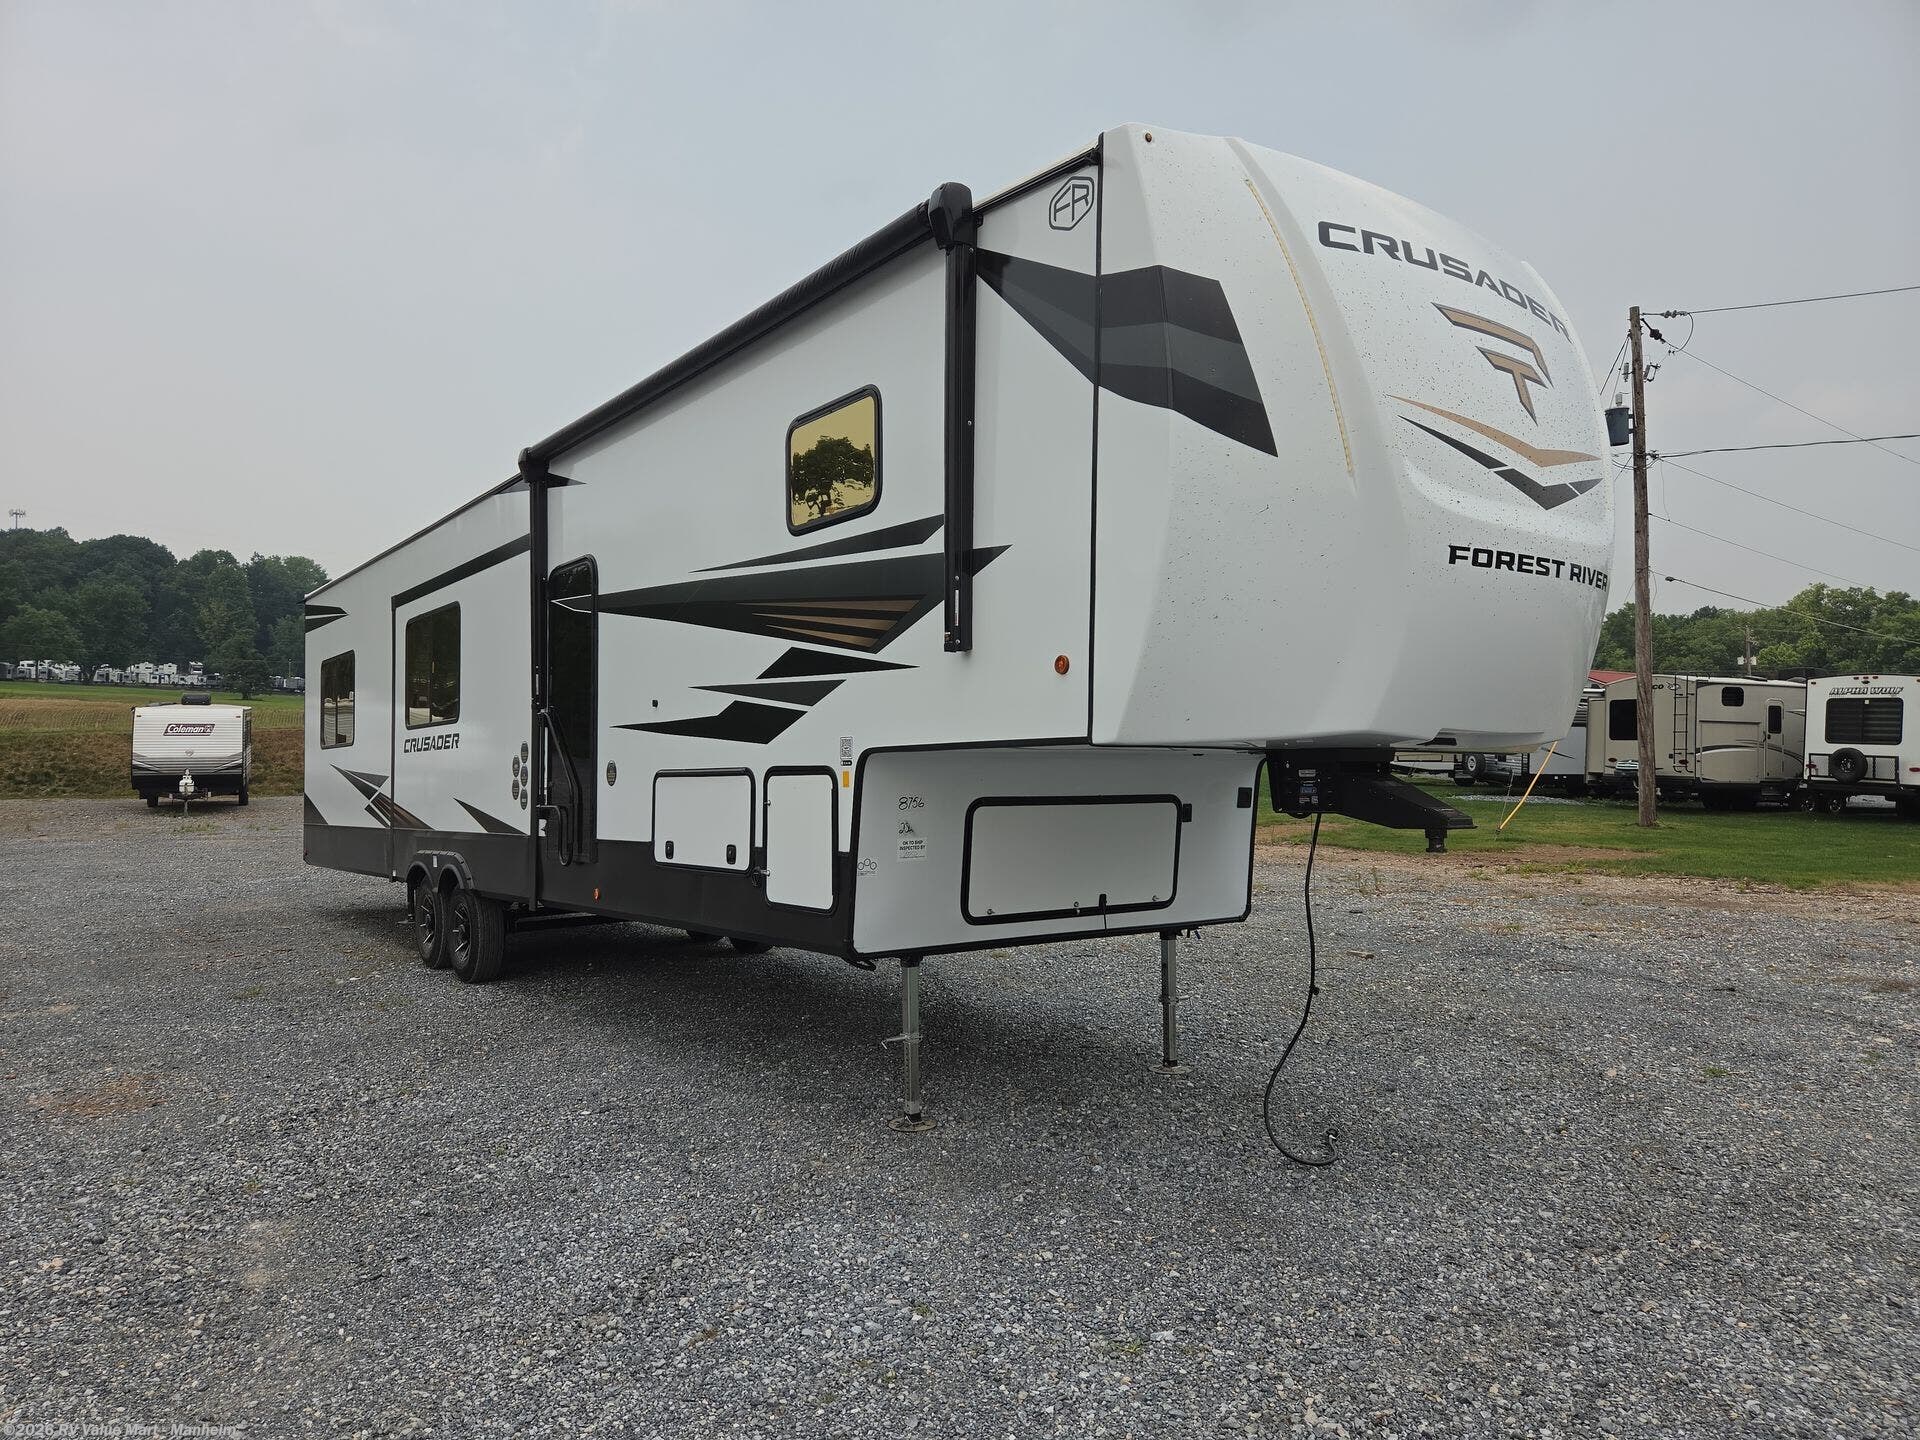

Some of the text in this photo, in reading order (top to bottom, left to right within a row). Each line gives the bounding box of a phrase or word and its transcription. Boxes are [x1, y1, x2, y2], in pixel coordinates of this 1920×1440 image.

[1317, 221, 1573, 345] CRUSADER
[1448, 544, 1608, 592] FOREST RIVER
[1829, 687, 1868, 696] ALPHA
[167, 724, 205, 733] Coleman
[404, 733, 460, 754] CRUSADER
[898, 796, 925, 810] 8756
